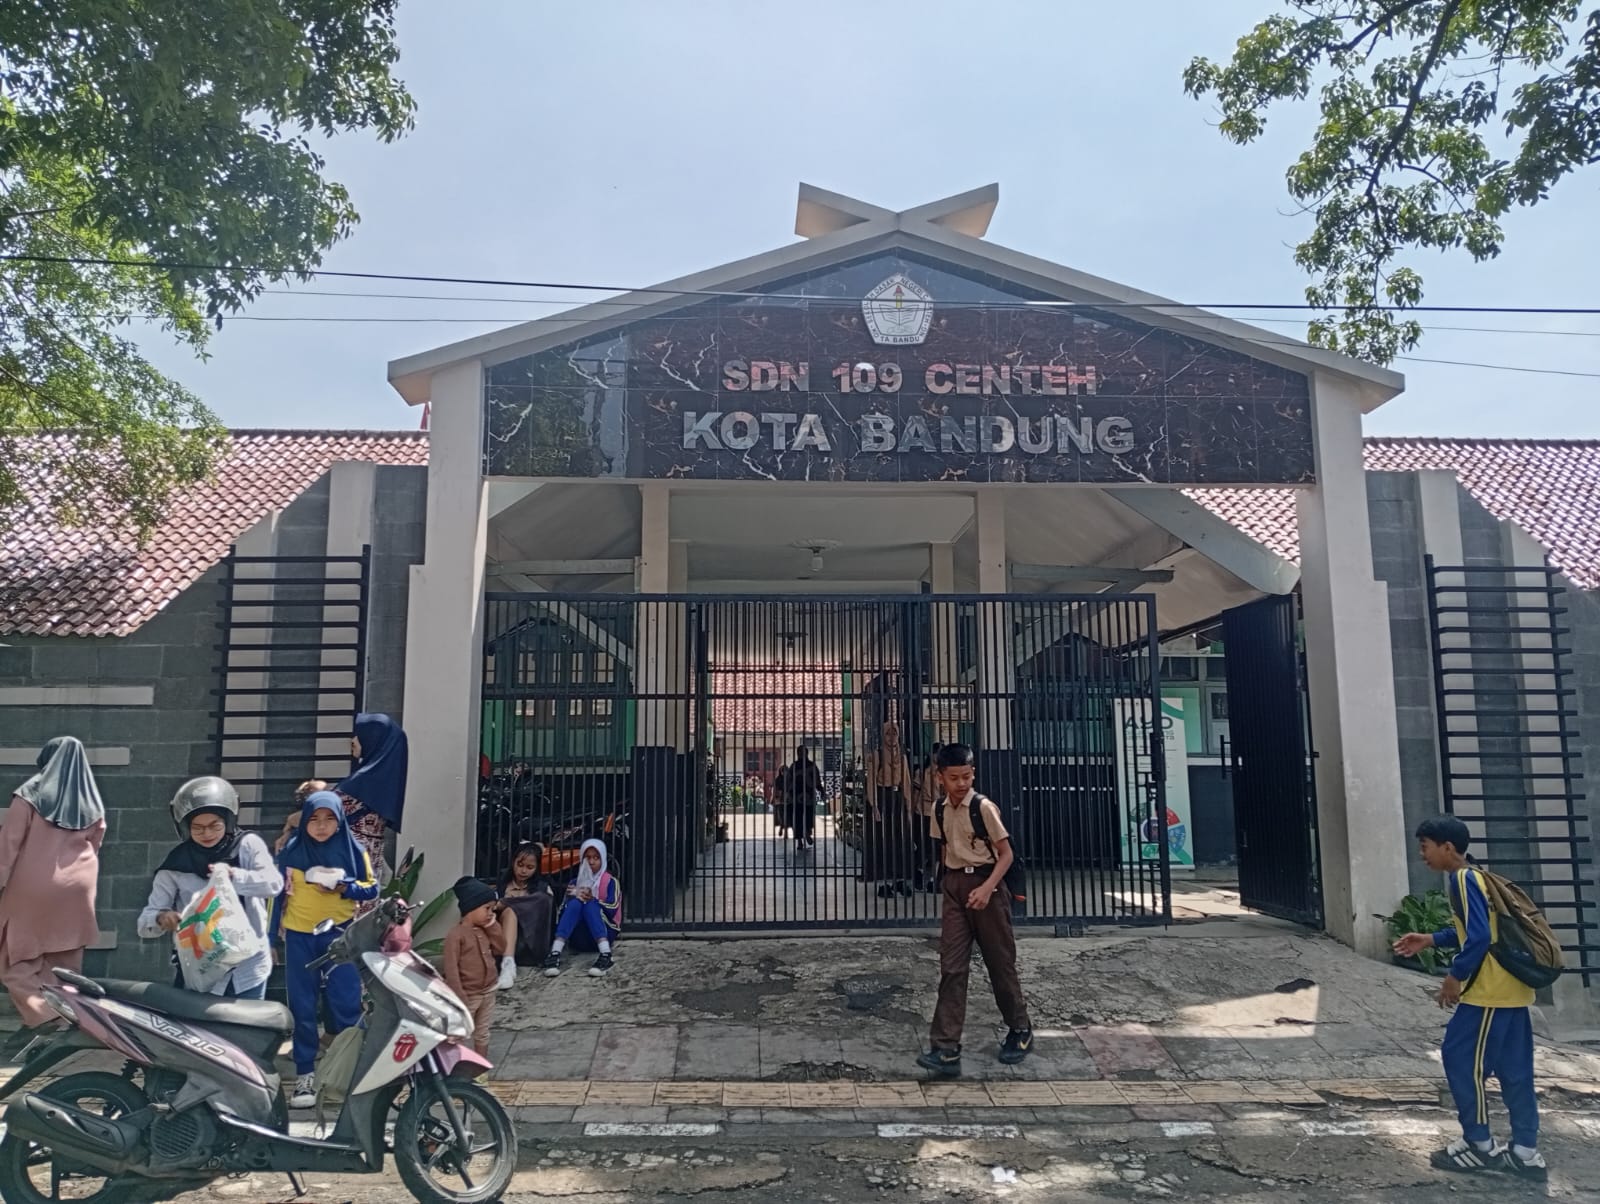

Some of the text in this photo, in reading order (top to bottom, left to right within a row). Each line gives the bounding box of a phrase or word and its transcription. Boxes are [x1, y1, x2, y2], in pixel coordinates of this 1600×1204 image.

[722, 361, 1097, 395] SDN 109 CENTEH
[683, 411, 1135, 454] KOTA BANDUNG
[150, 1013, 225, 1056] VARIO
